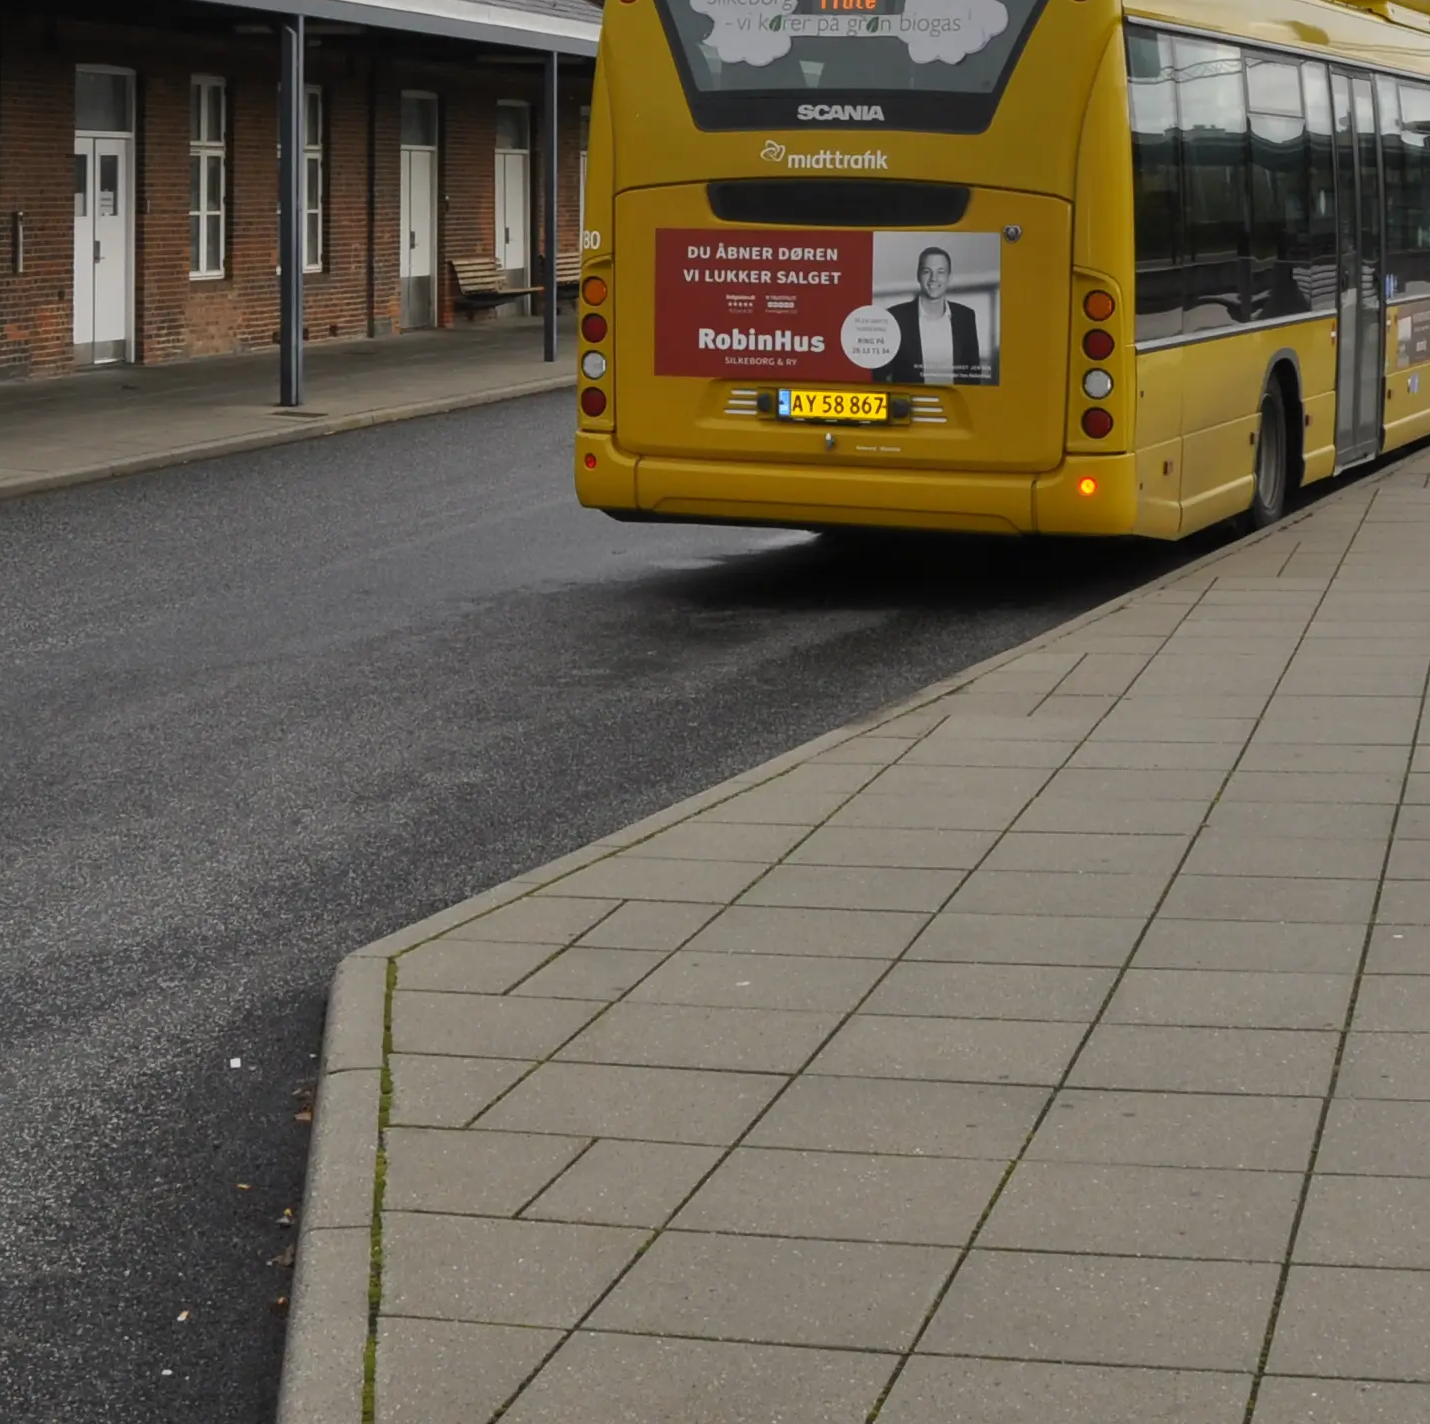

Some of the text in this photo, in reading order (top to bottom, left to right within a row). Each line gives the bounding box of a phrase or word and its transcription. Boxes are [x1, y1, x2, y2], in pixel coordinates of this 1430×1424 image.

[737, 14, 751, 31] vi
[818, 13, 840, 36] på
[899, 12, 961, 37] biogas
[797, 104, 885, 121] SCANIA
[787, 149, 889, 169] midttrafik
[687, 242, 838, 261] DU ÅBNER DØREN
[683, 268, 842, 285] VI LUKKER SALGET
[698, 328, 825, 352] RobinHus
[724, 356, 798, 366] SILKEBORG & RY
[792, 394, 884, 415] AY 58 867
